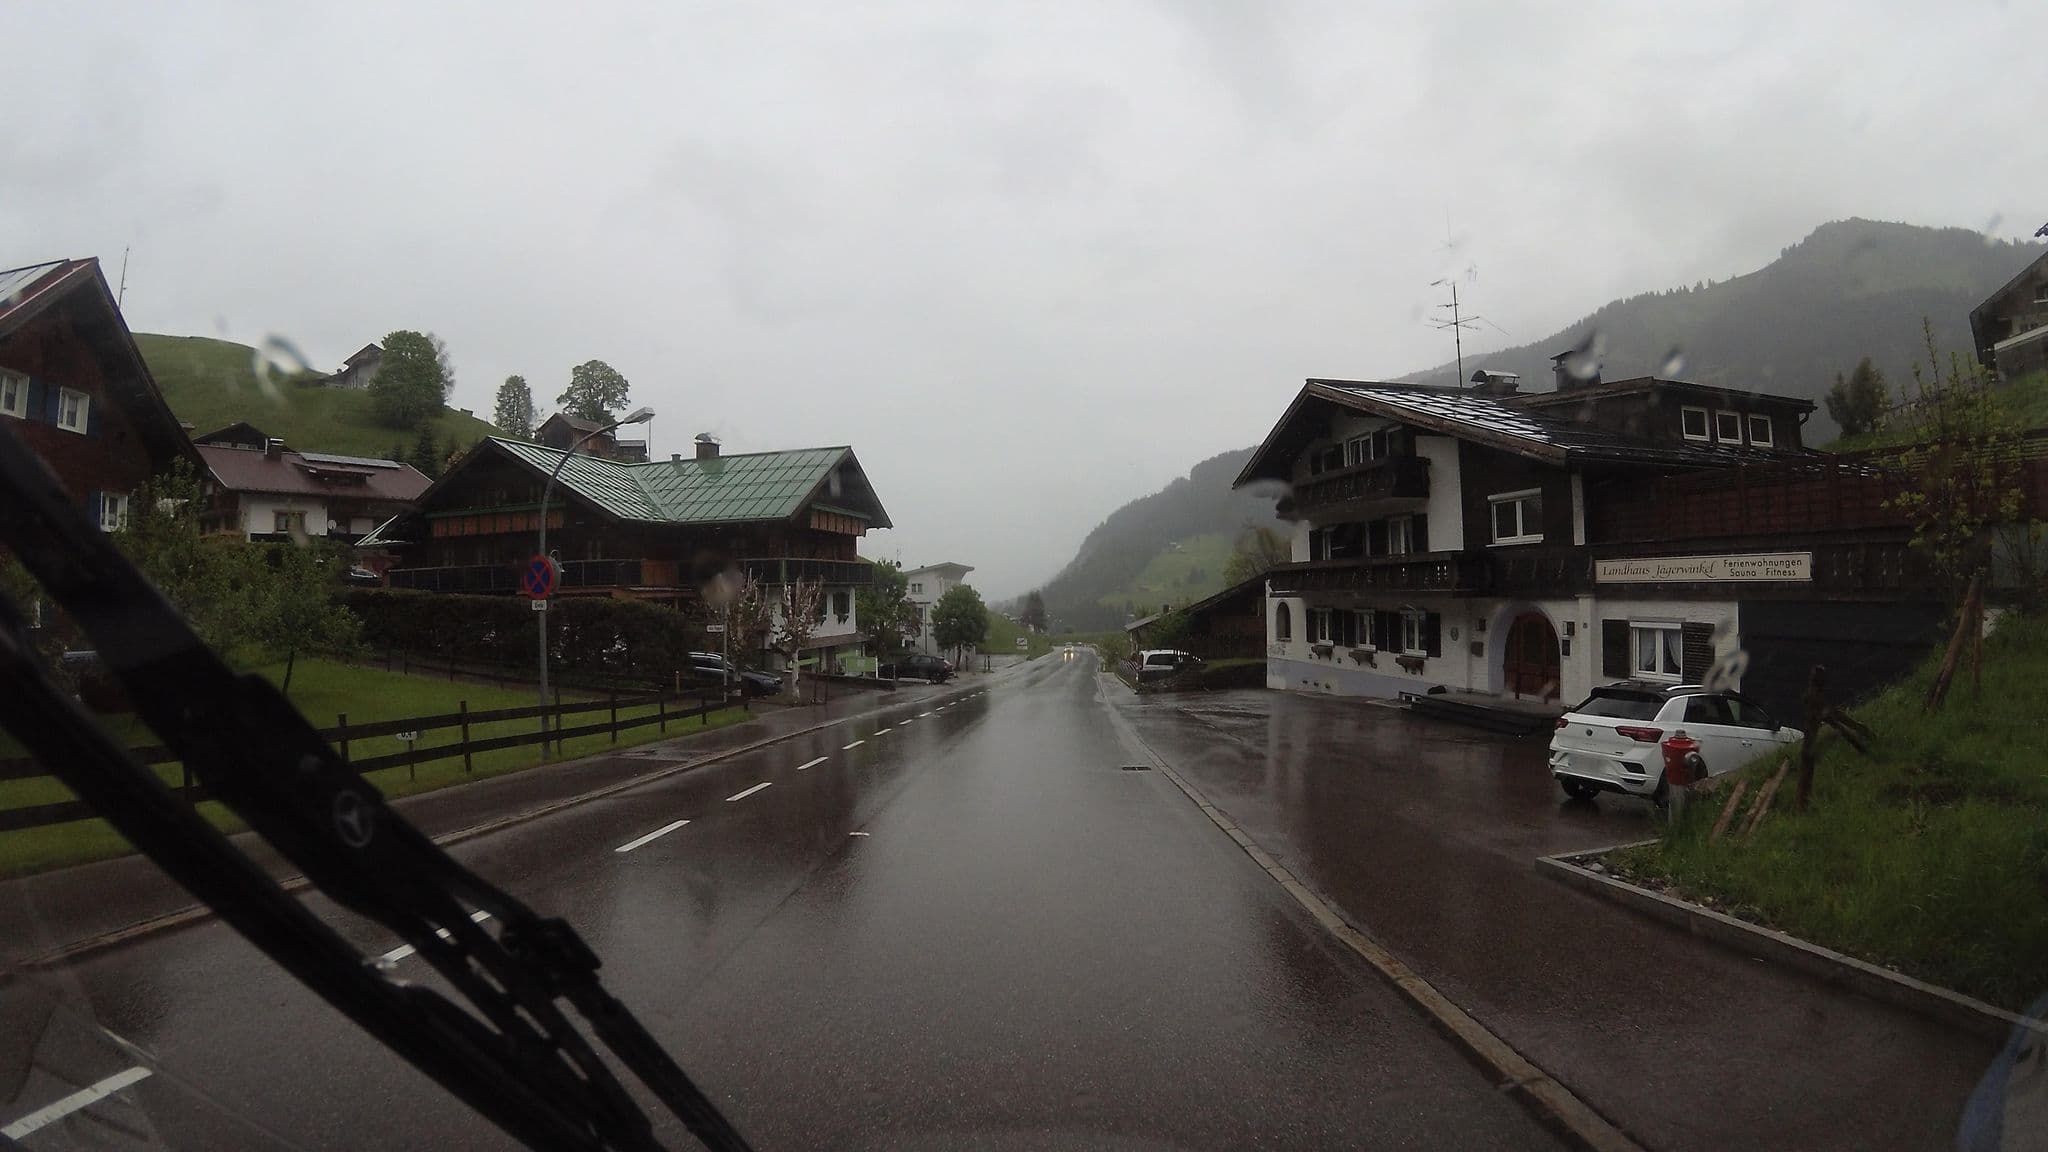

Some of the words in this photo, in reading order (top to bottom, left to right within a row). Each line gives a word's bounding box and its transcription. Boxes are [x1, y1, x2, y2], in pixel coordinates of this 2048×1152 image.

[1602, 562, 1650, 576] Landhaus
[1723, 558, 1802, 569] Ferienwohnungen
[1730, 568, 1757, 577] Sauna
[1765, 567, 1797, 577] Fitness
